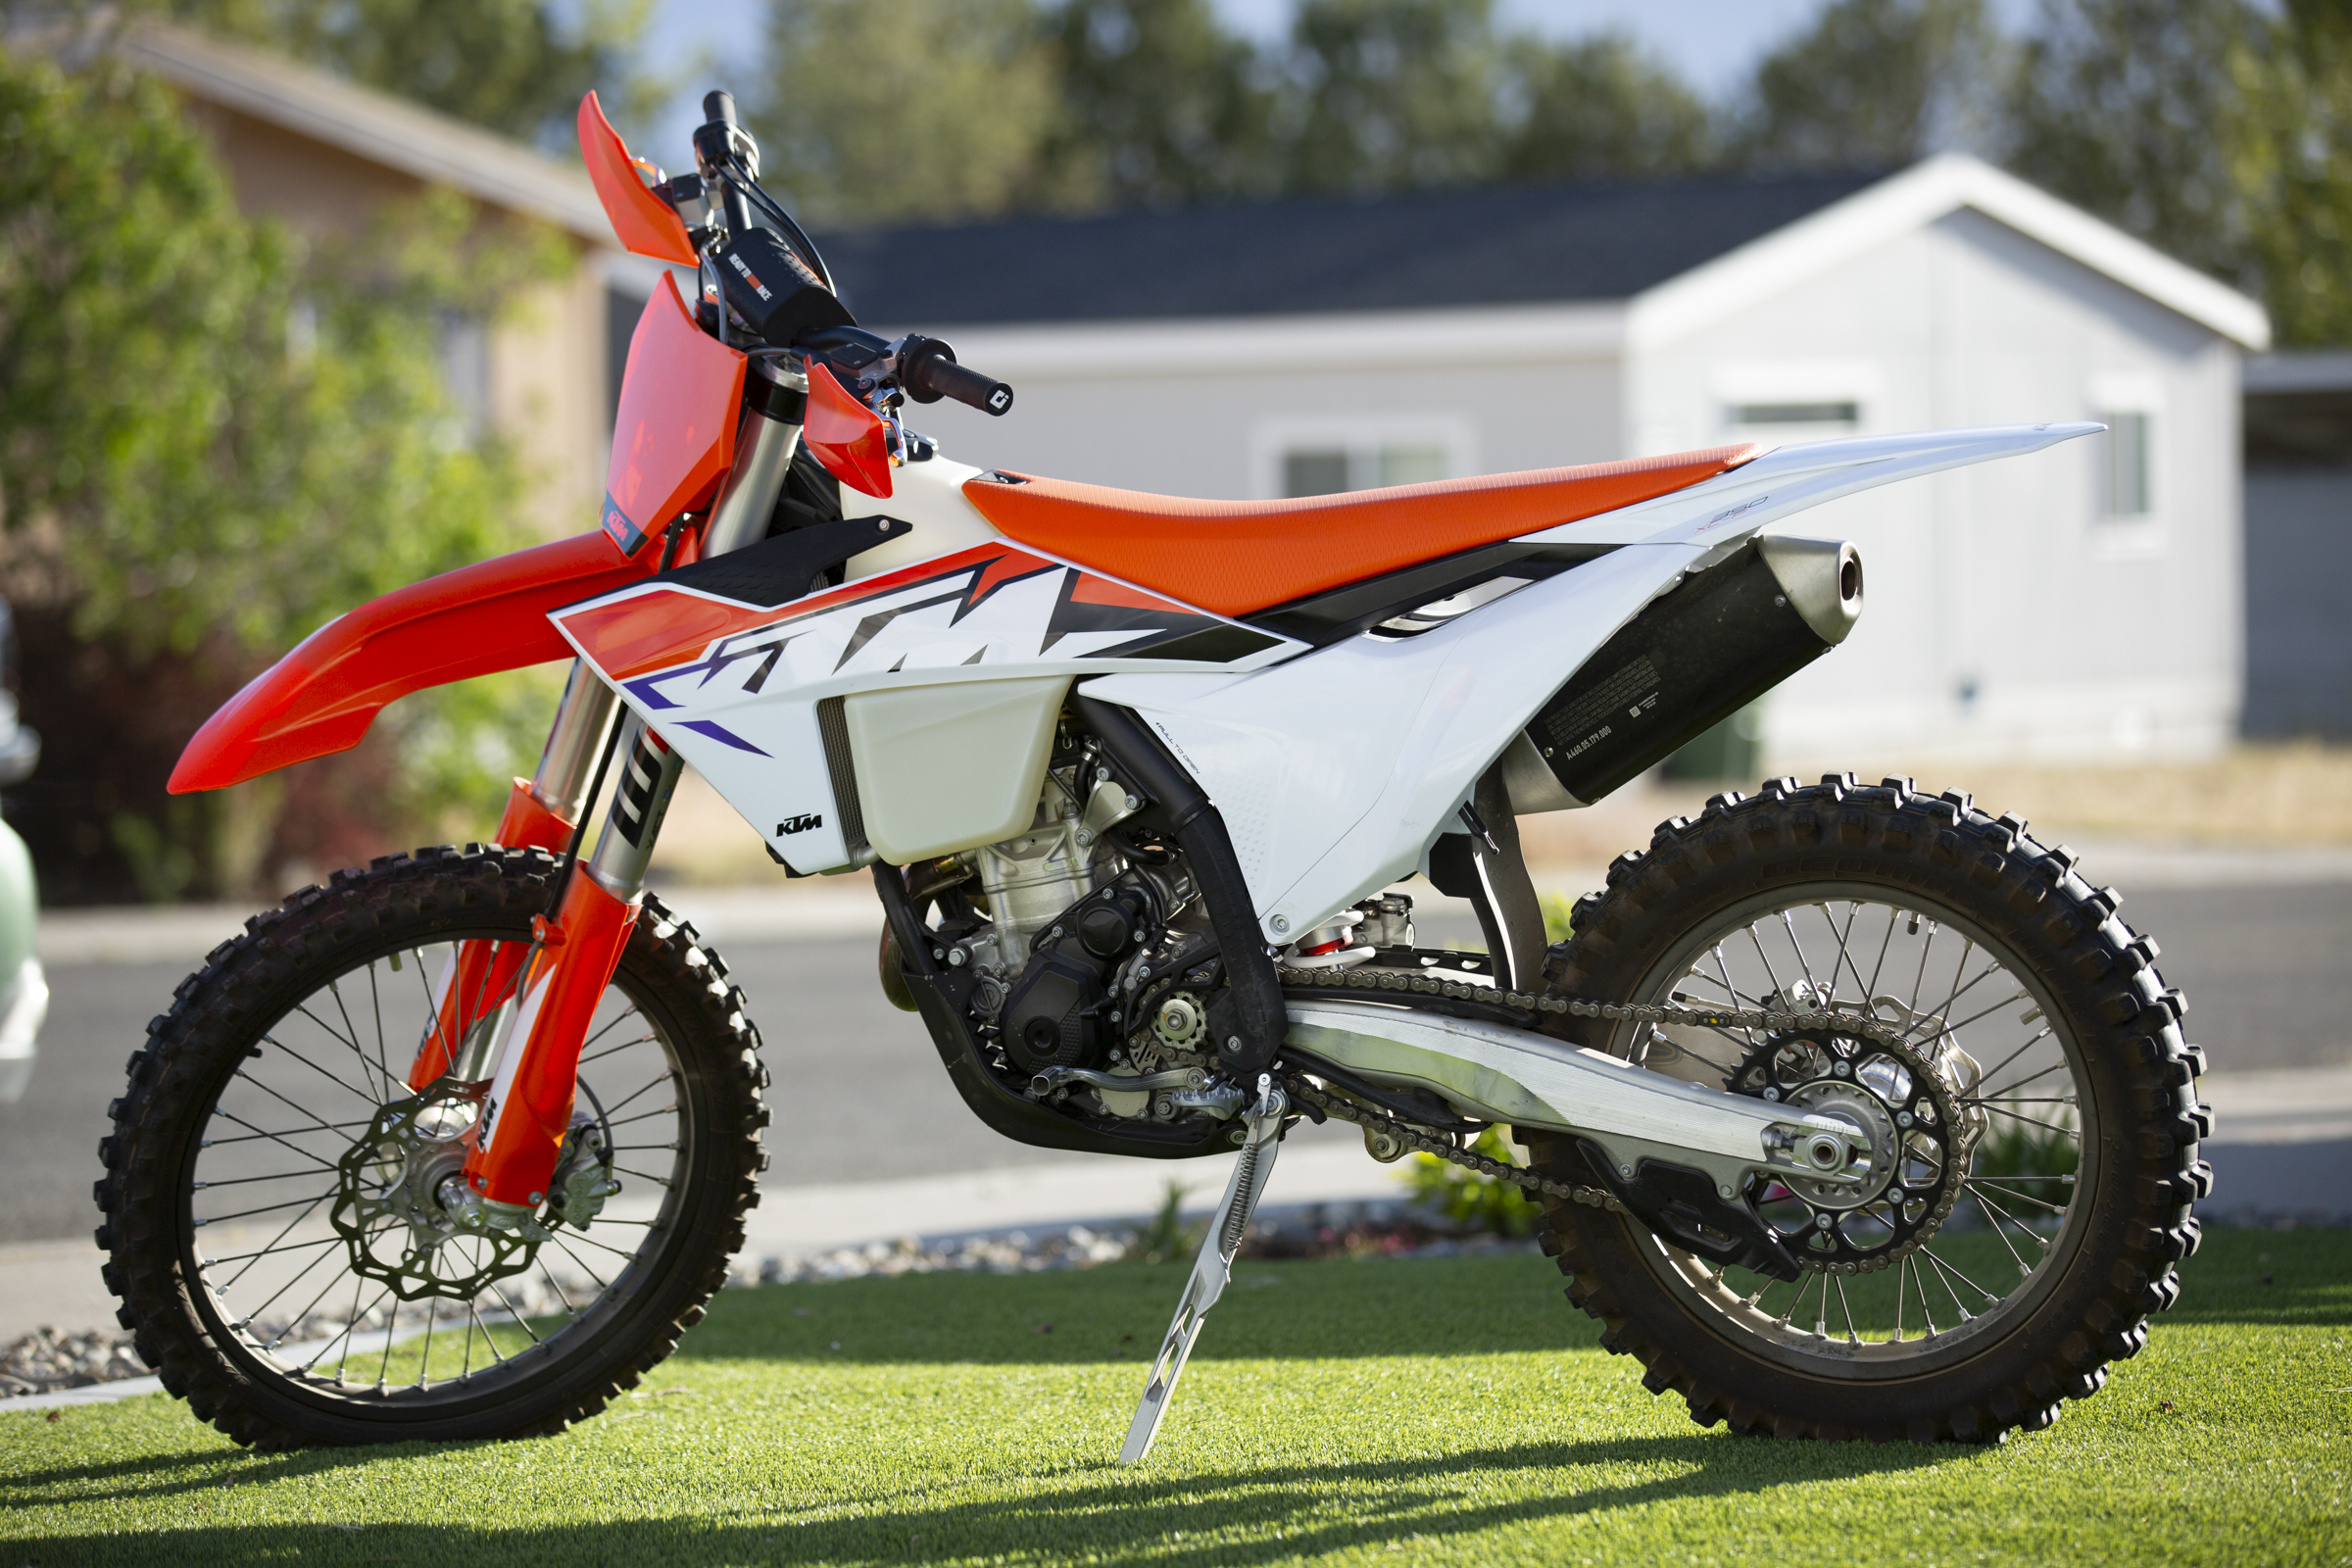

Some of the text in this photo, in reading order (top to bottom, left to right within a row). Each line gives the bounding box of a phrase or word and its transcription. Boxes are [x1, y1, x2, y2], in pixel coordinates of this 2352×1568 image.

[756, 284, 772, 301] RACE
[606, 510, 629, 542] KTM
[1175, 743, 1184, 755] TO
[776, 812, 822, 838] KTM
